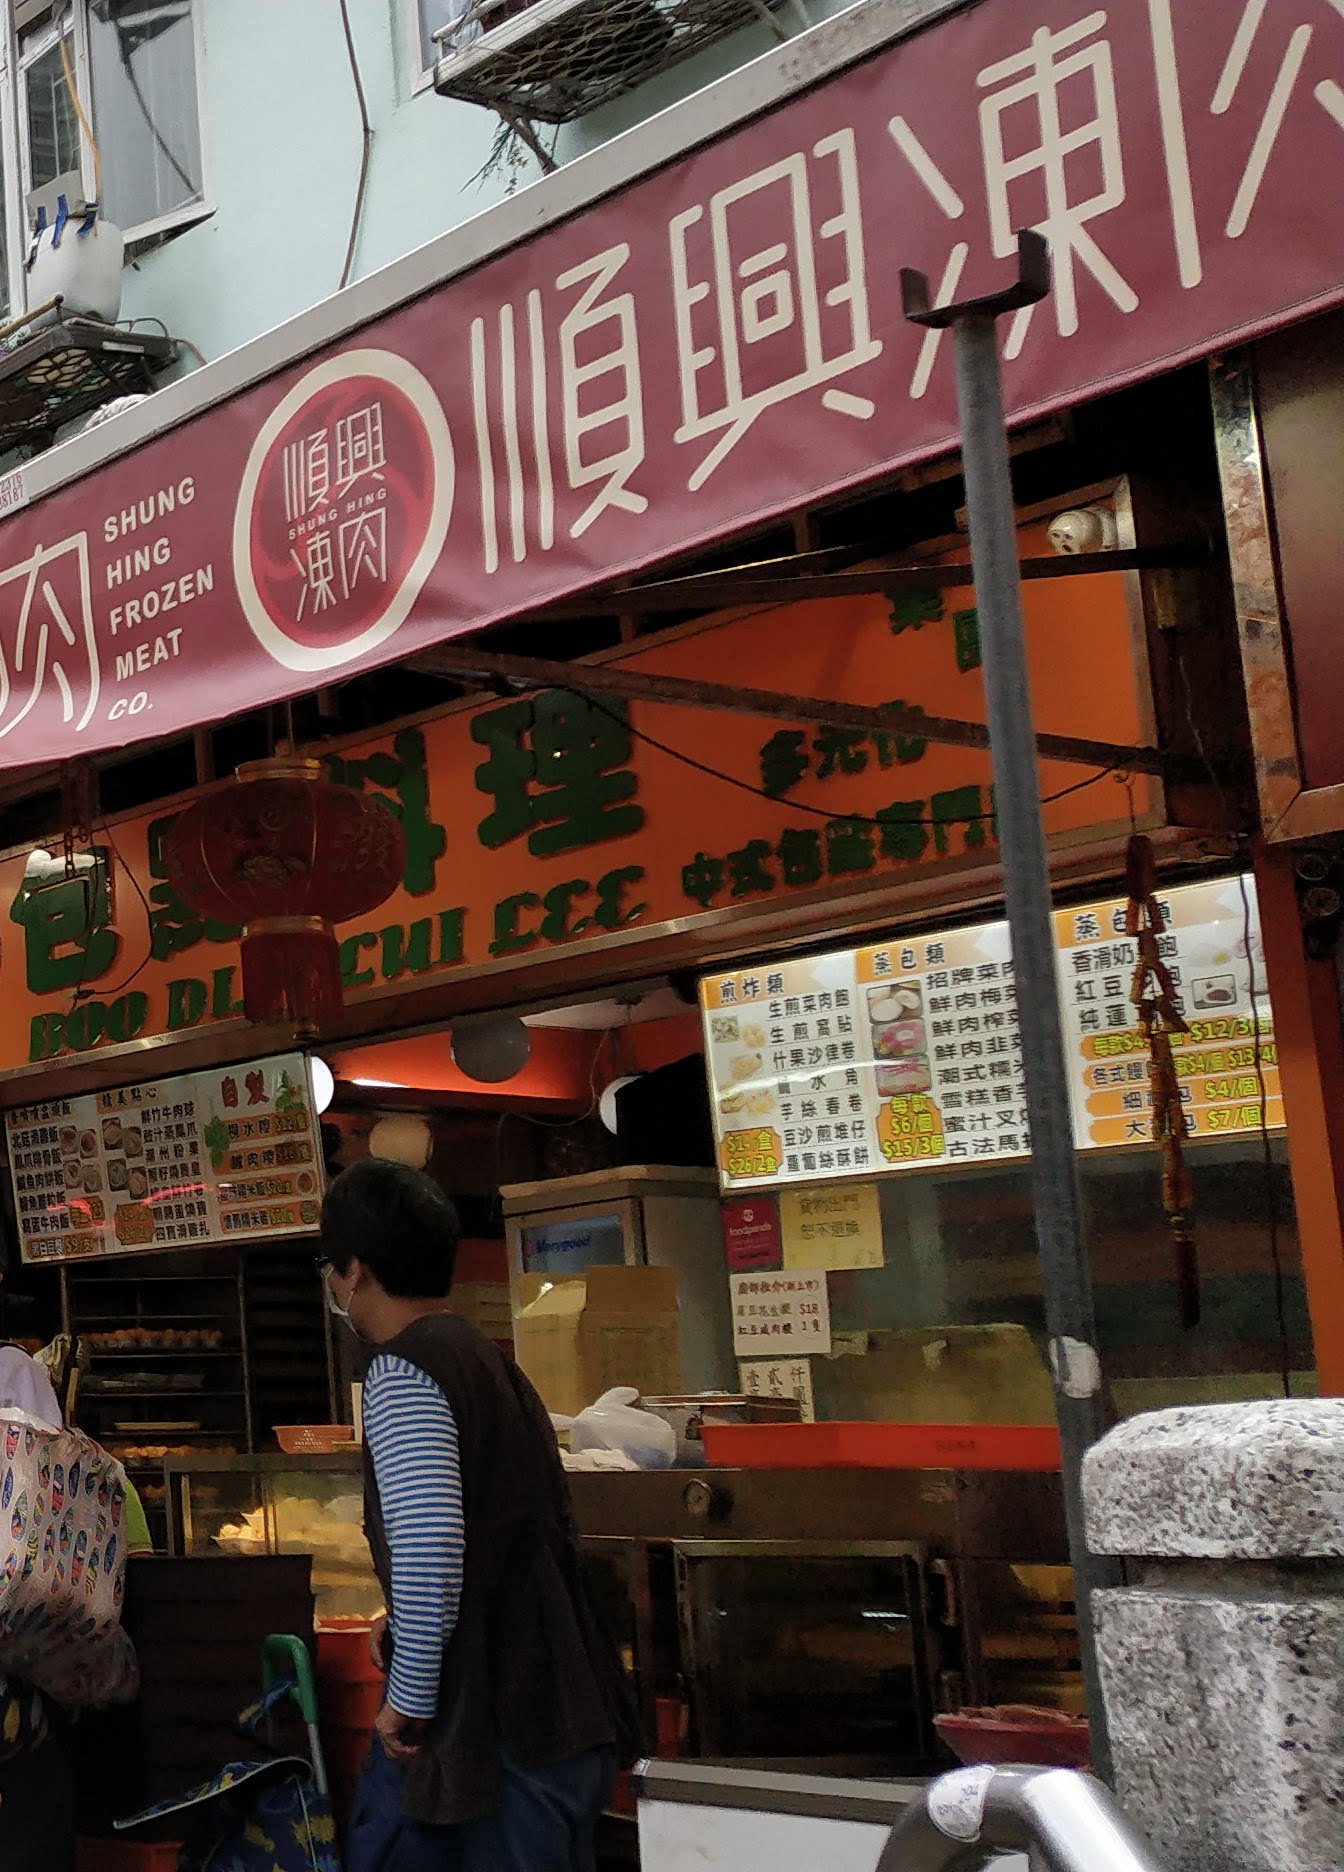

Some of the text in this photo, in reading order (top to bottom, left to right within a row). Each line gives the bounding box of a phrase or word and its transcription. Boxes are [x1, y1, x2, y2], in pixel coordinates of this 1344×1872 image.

[282, 402, 387, 523] 順興
[103, 476, 197, 544] SHUNG
[287, 487, 388, 541] SHUNG HING
[105, 537, 172, 590] HING
[288, 506, 388, 623] 凍肉
[109, 564, 215, 636] FROZEN
[115, 627, 183, 682] MEAT
[107, 692, 155, 721] CO.
[872, 941, 945, 977] 蒸包類
[719, 972, 785, 1004] 煎炸類
[27, 990, 149, 1063] BOO
[1204, 1075, 1259, 1099] $4/個
[1206, 1104, 1262, 1130] $7/個
